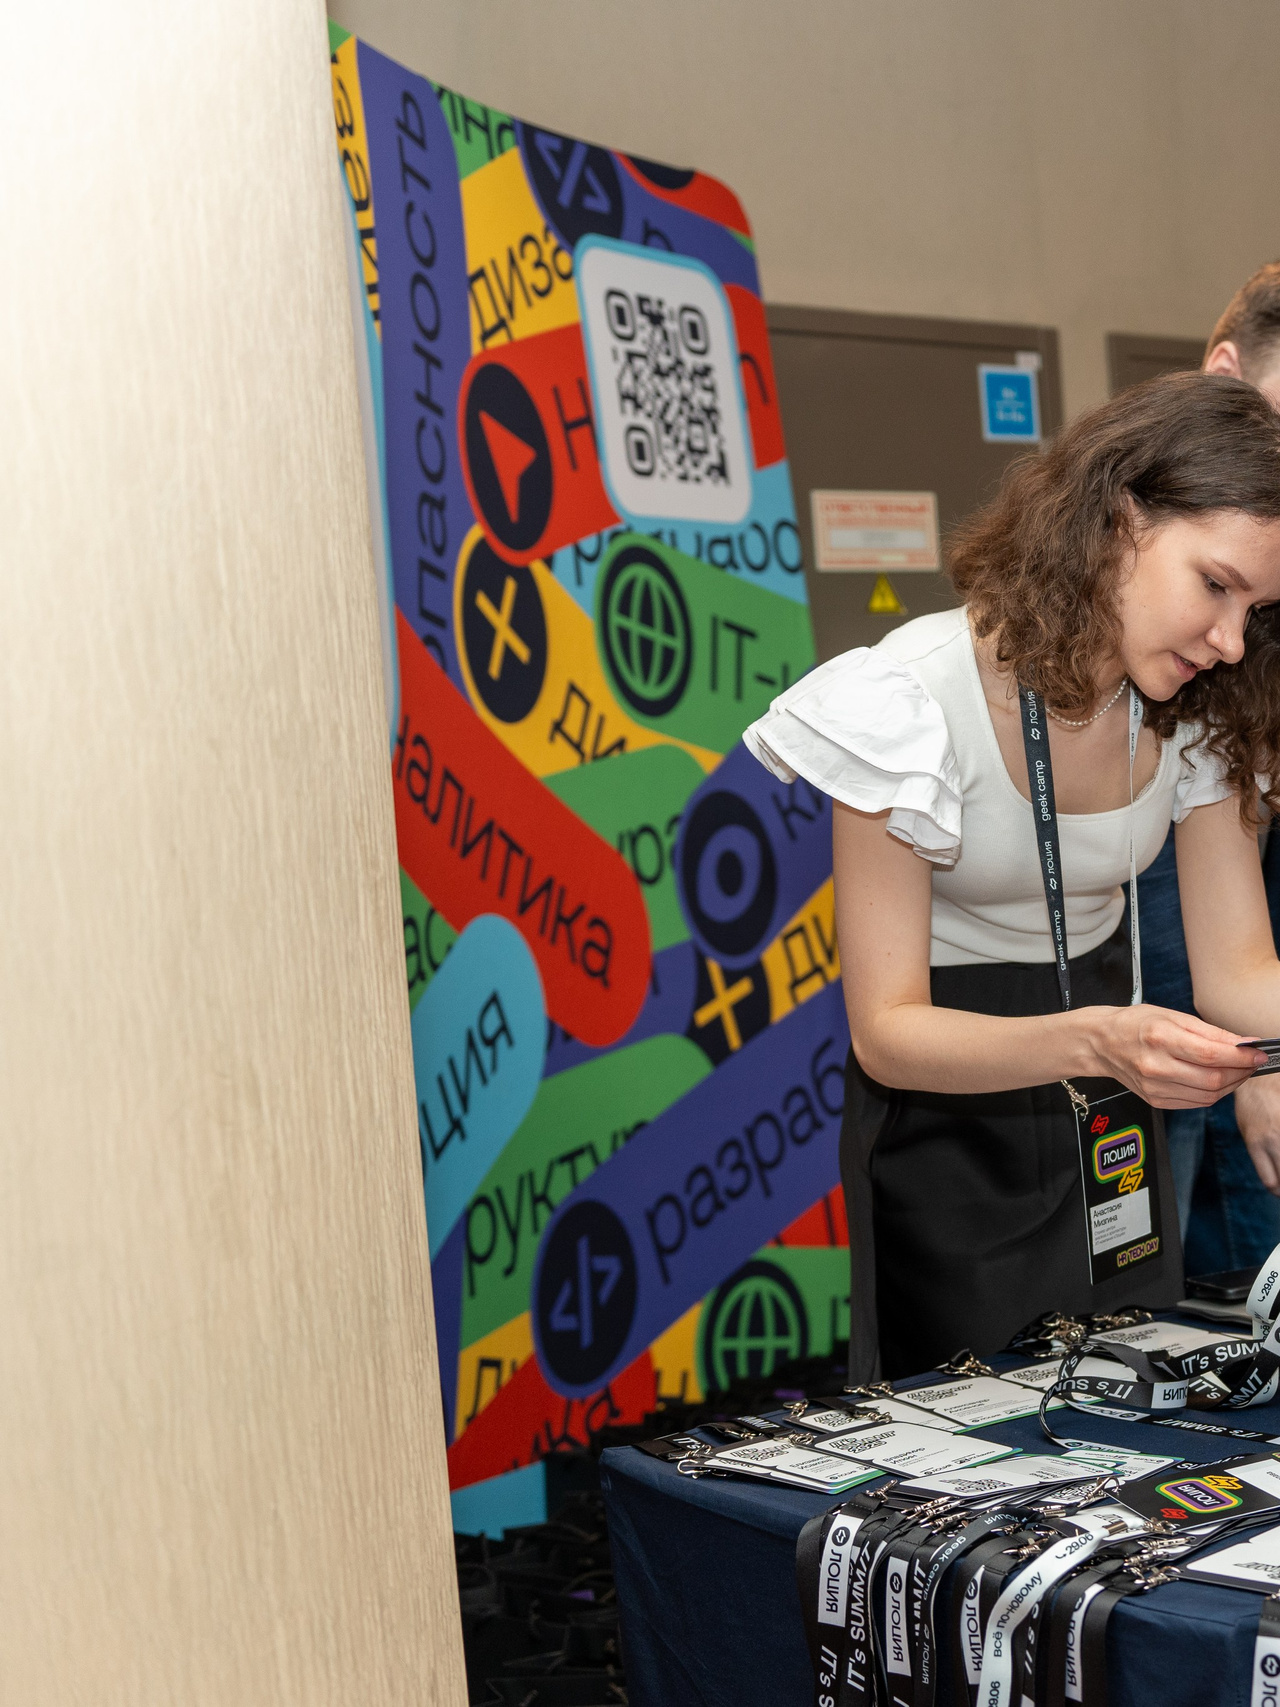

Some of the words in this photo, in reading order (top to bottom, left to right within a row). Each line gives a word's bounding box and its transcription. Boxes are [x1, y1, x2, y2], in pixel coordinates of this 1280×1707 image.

[1036, 759, 1047, 793] camp
[1040, 794, 1052, 822] geek
[1053, 909, 1063, 941] camp
[1059, 942, 1068, 971] geek
[1117, 1252, 1128, 1266] HR
[1128, 1244, 1145, 1260] TECH
[1145, 1239, 1159, 1253] DAY
[1261, 1270, 1279, 1297] 29.06
[1181, 1356, 1209, 1376] IT's
[1215, 1338, 1264, 1362] SUM
[1096, 1380, 1134, 1400] IT's
[1152, 1418, 1228, 1435] SUMMIT
[938, 1535, 967, 1562] geek
[1065, 1532, 1095, 1557] 29.06
[850, 1540, 872, 1642] SUMMIT
[995, 1571, 1044, 1630] по-новому
[993, 1632, 1003, 1658] всё
[819, 1645, 838, 1688] IT's
[846, 1647, 867, 1692] IT's
